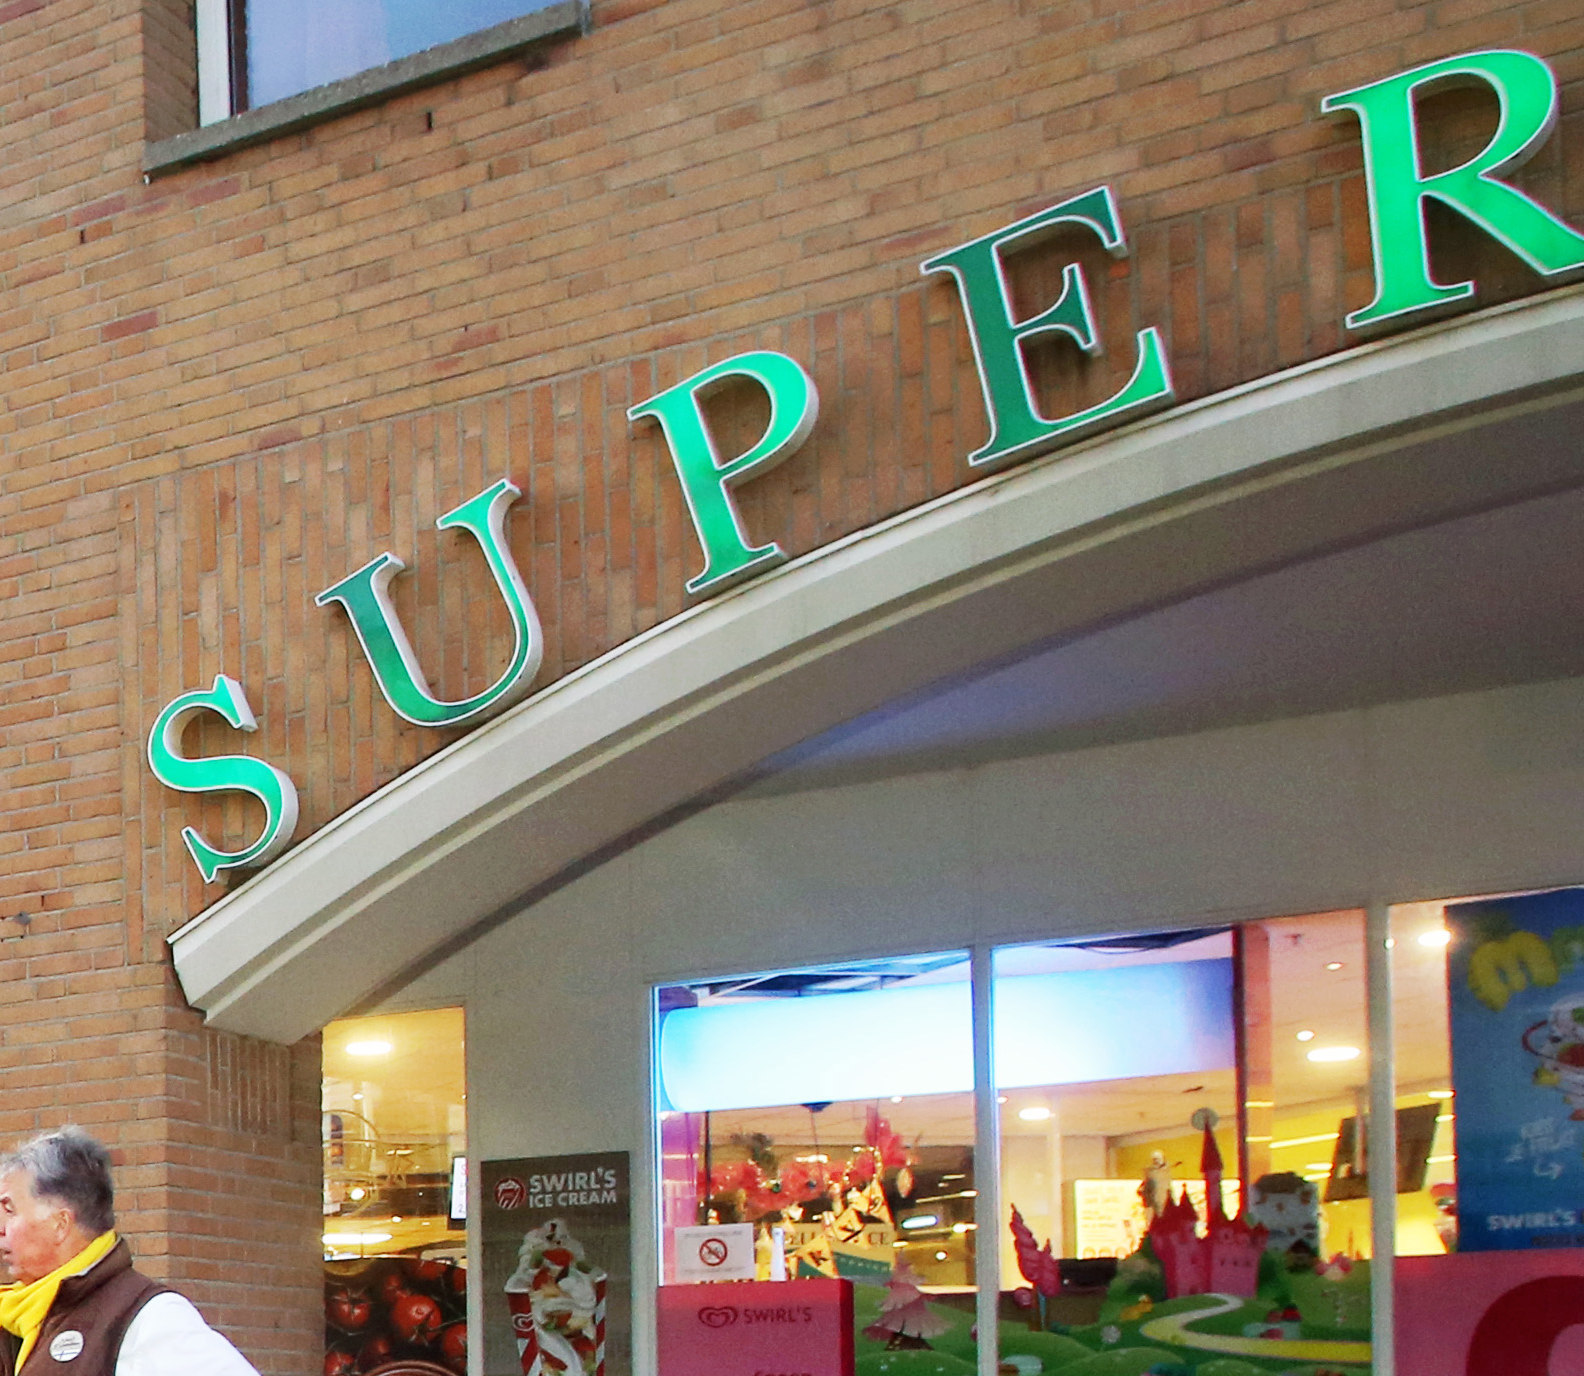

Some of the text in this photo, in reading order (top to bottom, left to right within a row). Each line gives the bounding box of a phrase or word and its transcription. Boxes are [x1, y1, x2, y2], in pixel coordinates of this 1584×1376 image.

[144, 47, 1584, 884] SUPER
[528, 1166, 618, 1193] SWIRL'S
[528, 1190, 618, 1209] ICE CREAM
[743, 1305, 813, 1324] SWIRL'S
